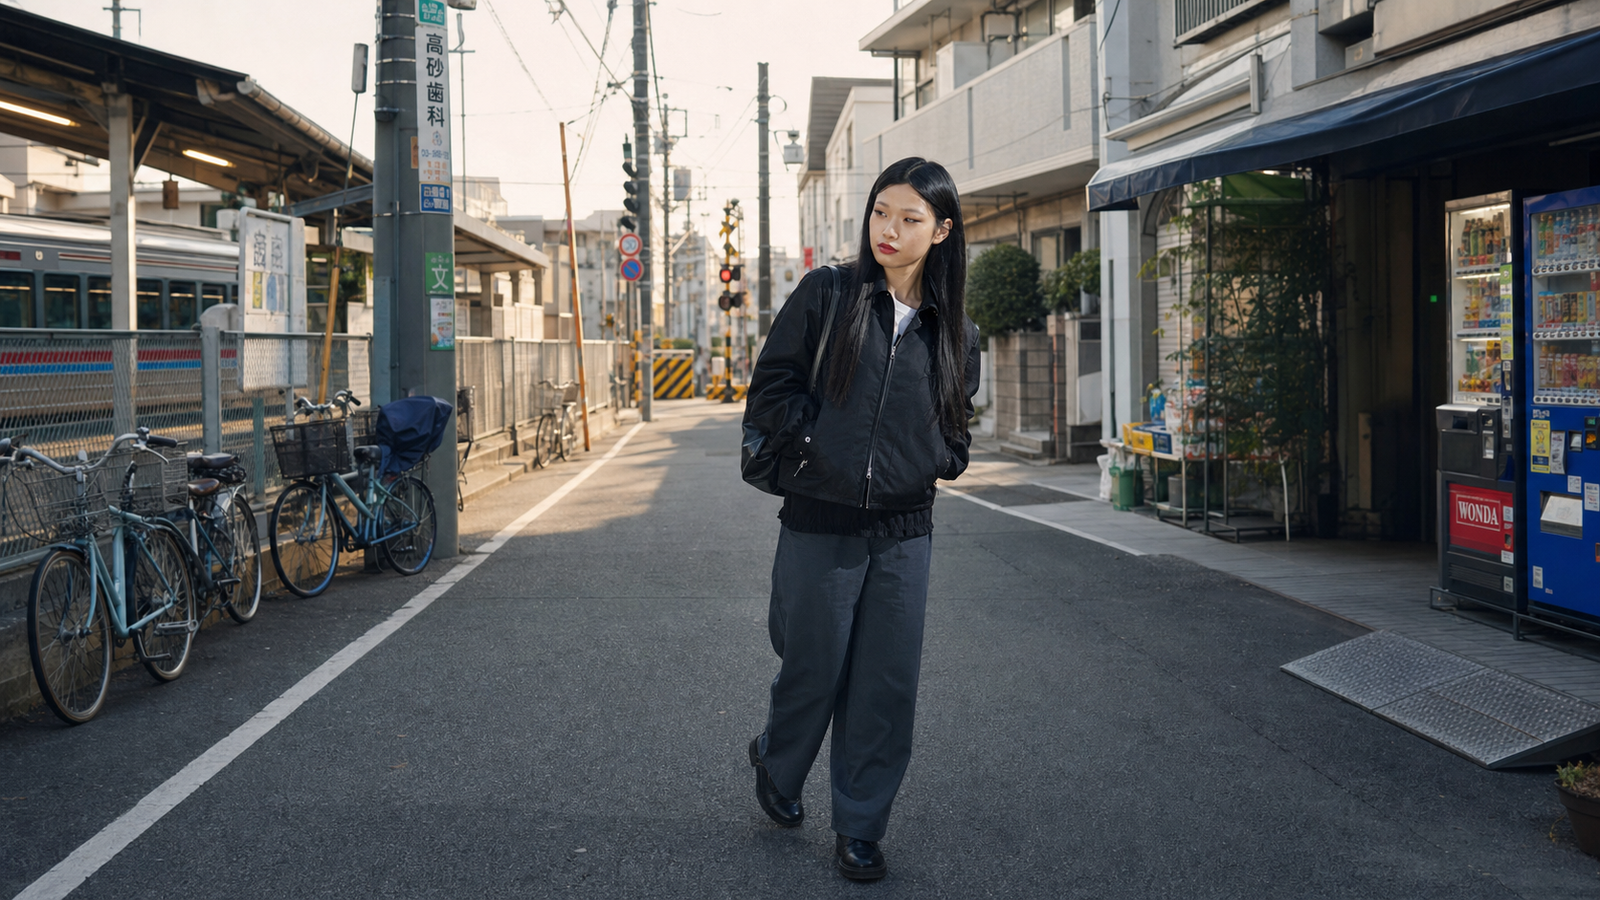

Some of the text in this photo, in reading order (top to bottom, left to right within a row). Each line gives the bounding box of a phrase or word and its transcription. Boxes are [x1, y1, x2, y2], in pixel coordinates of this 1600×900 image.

[426, 33, 445, 128] 高砂歯科
[431, 264, 449, 290] 文
[1458, 501, 1499, 525] WONDA
